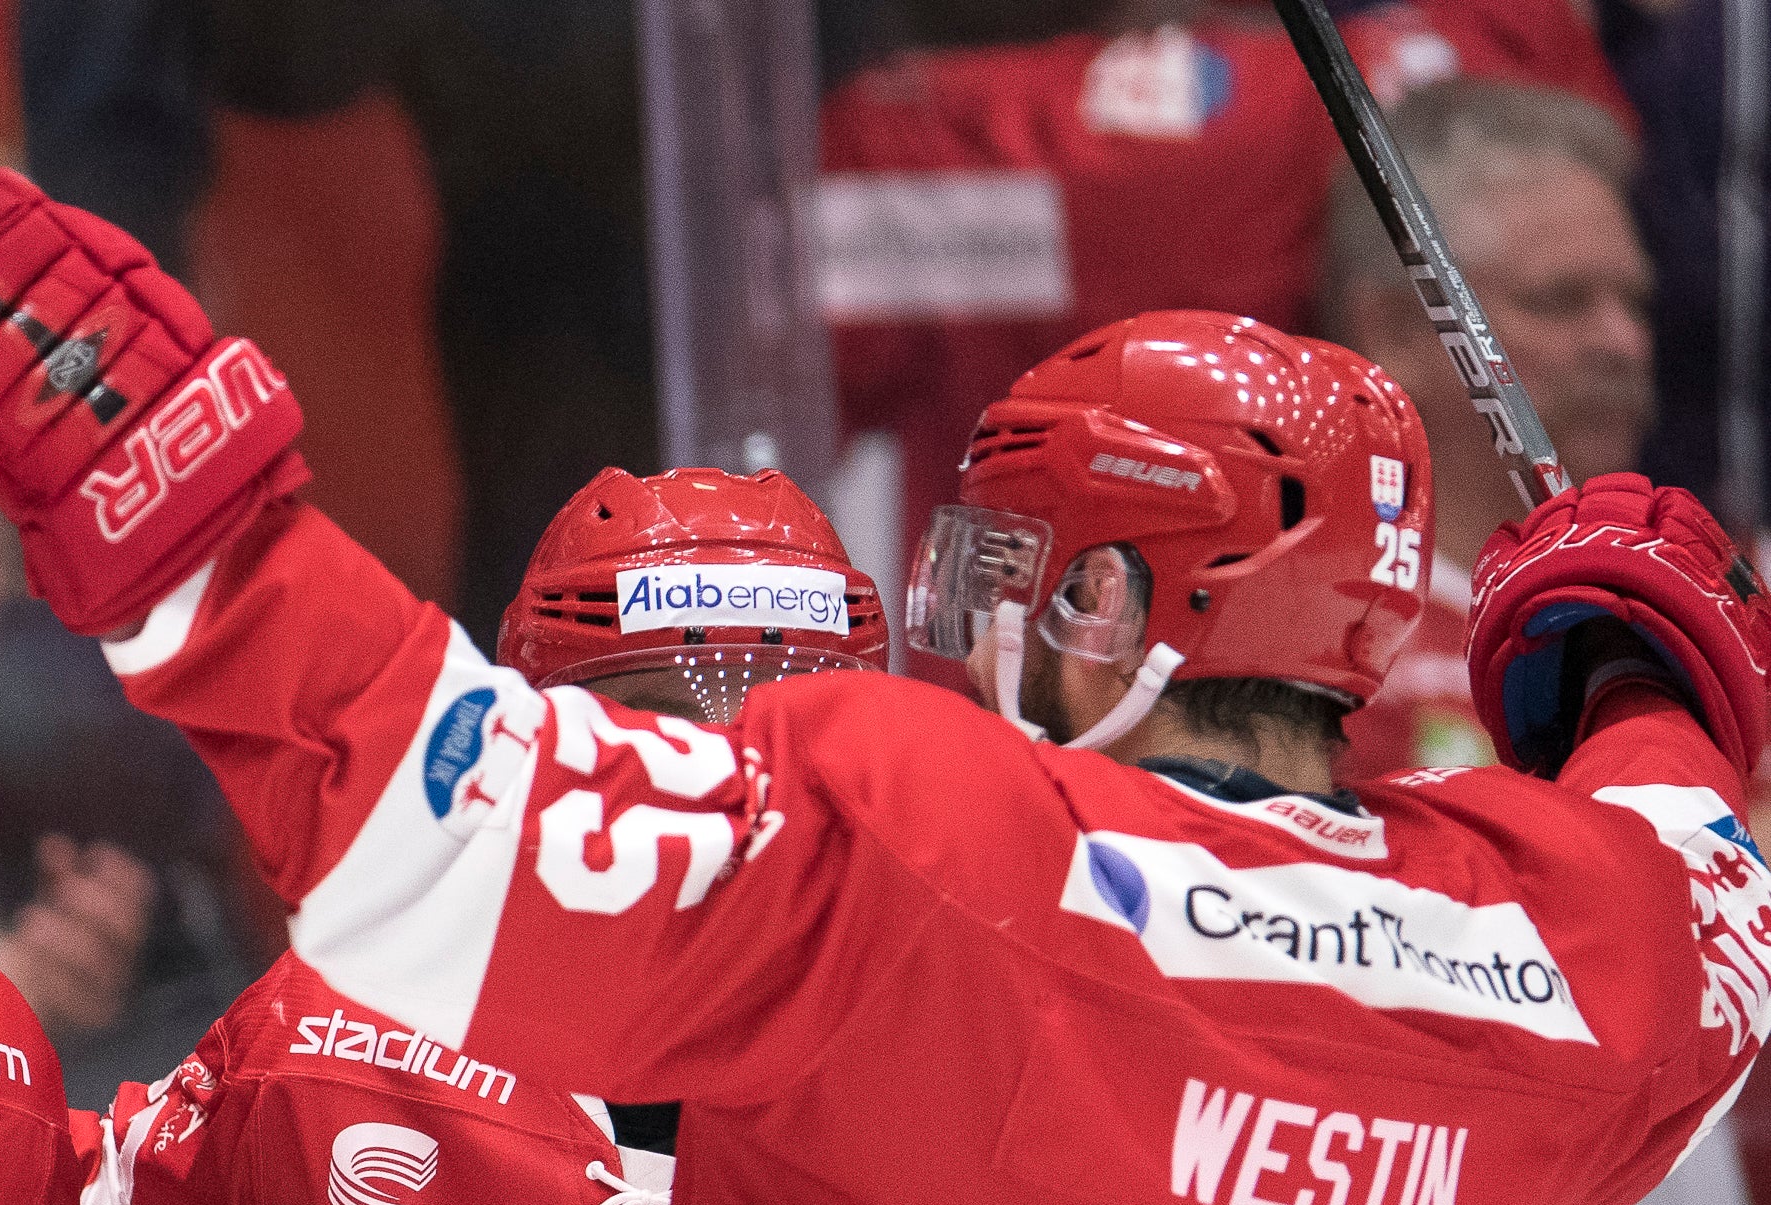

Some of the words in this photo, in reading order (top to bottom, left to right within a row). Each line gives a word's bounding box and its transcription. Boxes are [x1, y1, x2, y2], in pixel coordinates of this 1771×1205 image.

[81, 336, 286, 543] UER
[621, 573, 845, 625] Aiabenergy
[1370, 522, 1422, 591] 25
[535, 685, 738, 917] 25
[1264, 796, 1372, 852] BAUER
[1184, 884, 1371, 970] Grant
[289, 1008, 517, 1105] stadium
